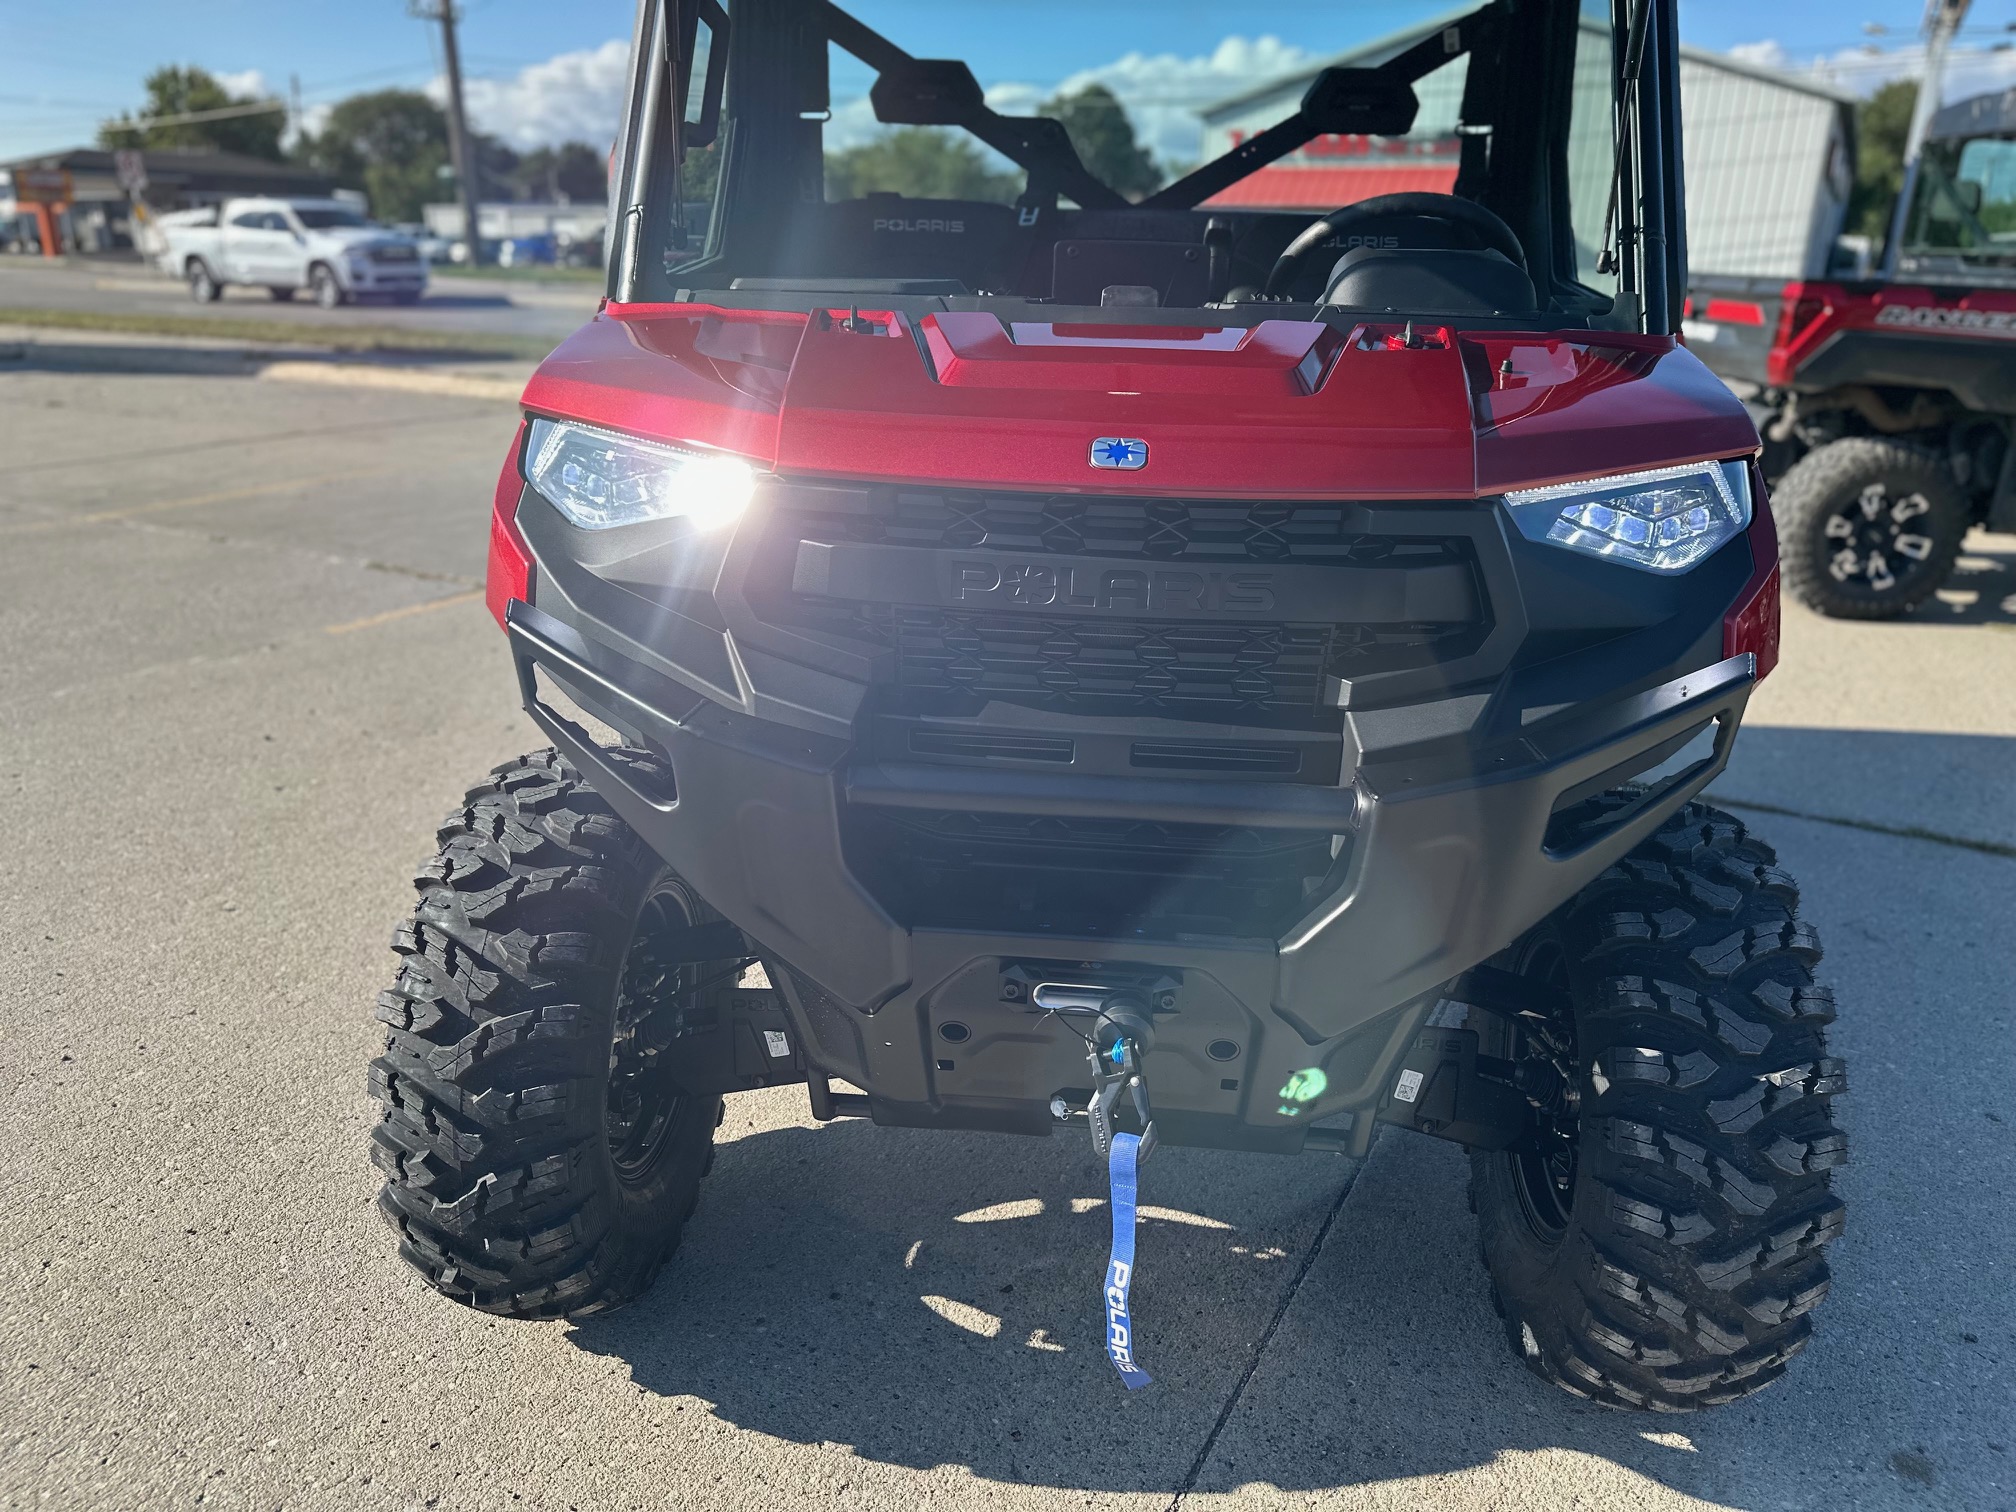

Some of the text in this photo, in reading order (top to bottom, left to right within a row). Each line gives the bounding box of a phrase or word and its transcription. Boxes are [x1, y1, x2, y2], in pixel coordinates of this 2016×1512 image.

[873, 219, 965, 233] POLARIS
[1321, 235, 1399, 248] LARIS
[951, 560, 1276, 612] POLARIS
[1106, 1259, 1139, 1374] POLARIS
